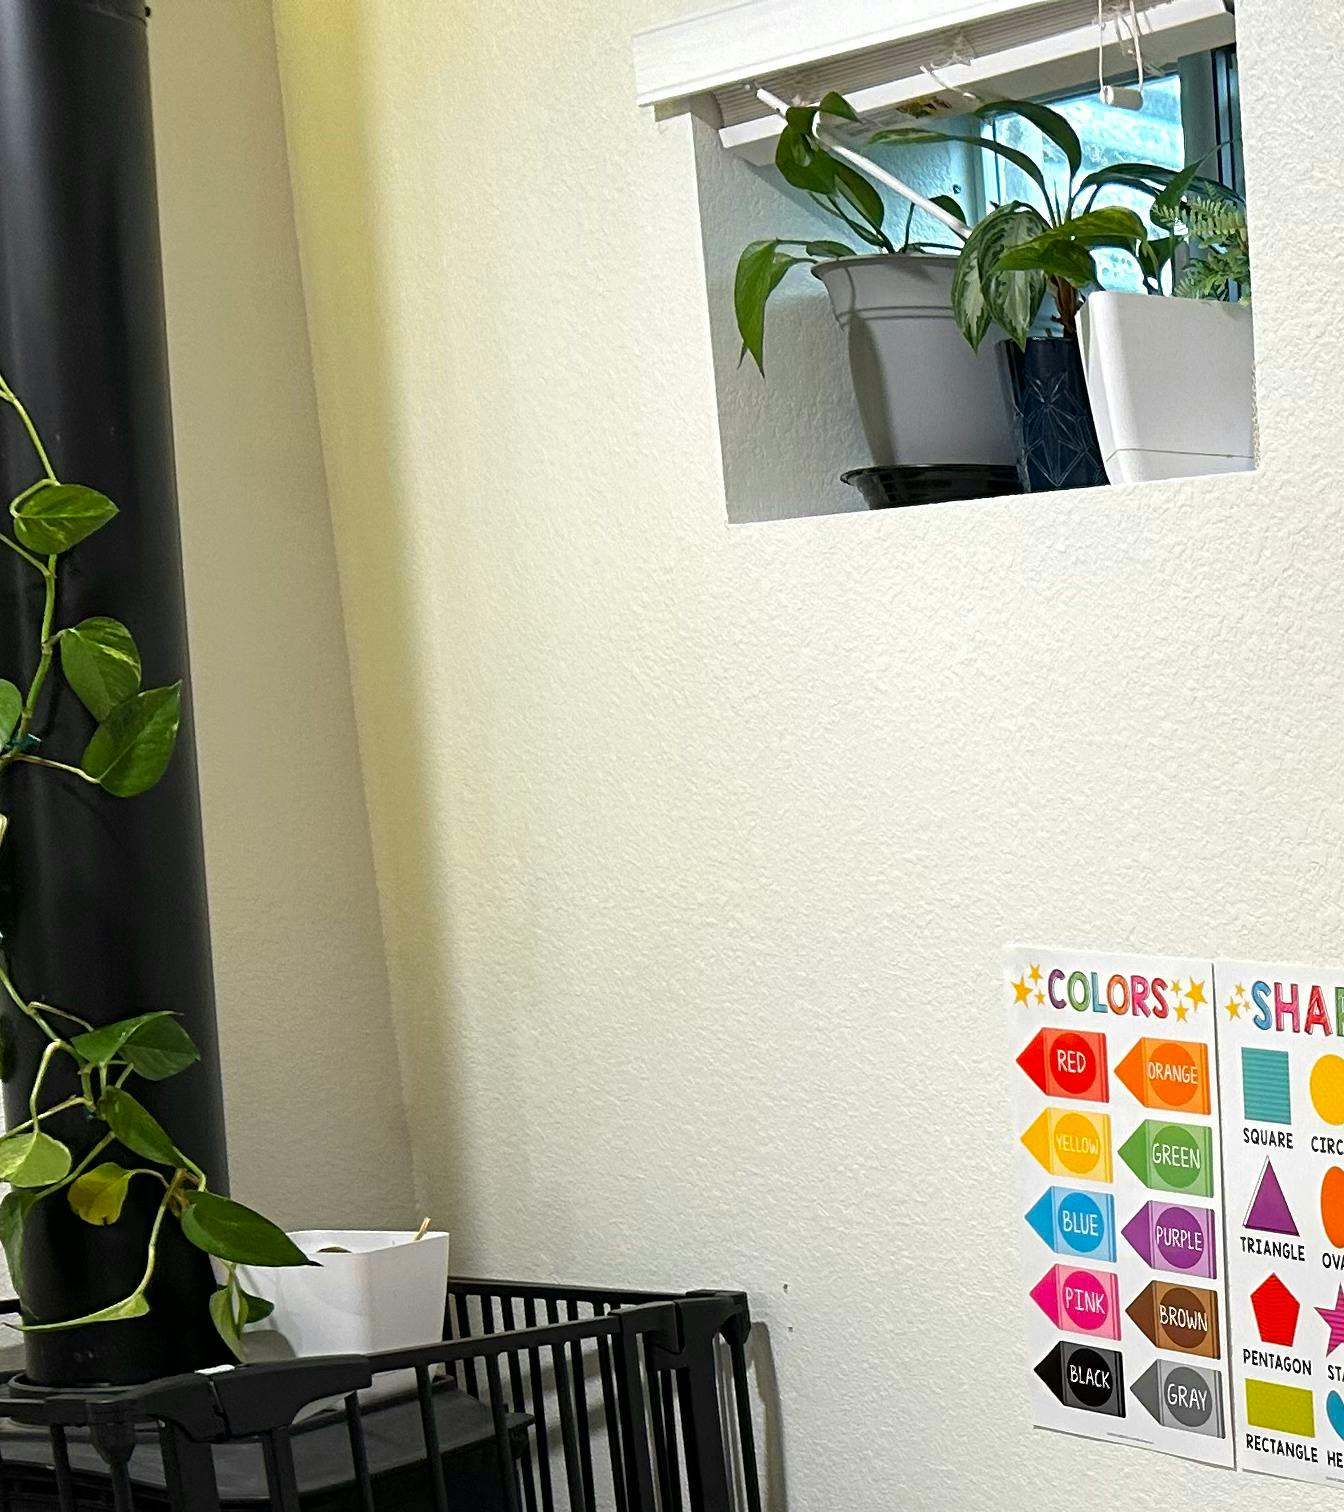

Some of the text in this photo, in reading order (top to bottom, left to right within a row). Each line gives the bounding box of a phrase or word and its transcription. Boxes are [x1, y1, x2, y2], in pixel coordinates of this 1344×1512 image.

[1047, 968, 1170, 1019] COLORS
[1057, 1050, 1087, 1073] RED
[1147, 1061, 1198, 1085] ORANGE
[1057, 1135, 1099, 1156] YELLOW
[1243, 1127, 1294, 1150] SQUARE
[1152, 1145, 1200, 1169] GREEN
[1062, 1210, 1098, 1236] BLUE
[1155, 1226, 1202, 1252] PURPLE
[1240, 1236, 1305, 1262] TRIANGLE
[1065, 1289, 1105, 1315] PINK
[1159, 1303, 1208, 1333] BROWN
[1243, 1349, 1312, 1376] PENTAGON
[1070, 1363, 1110, 1389] BLACK
[1167, 1383, 1208, 1411] GRAY
[1246, 1433, 1318, 1464] RECTANGLE
